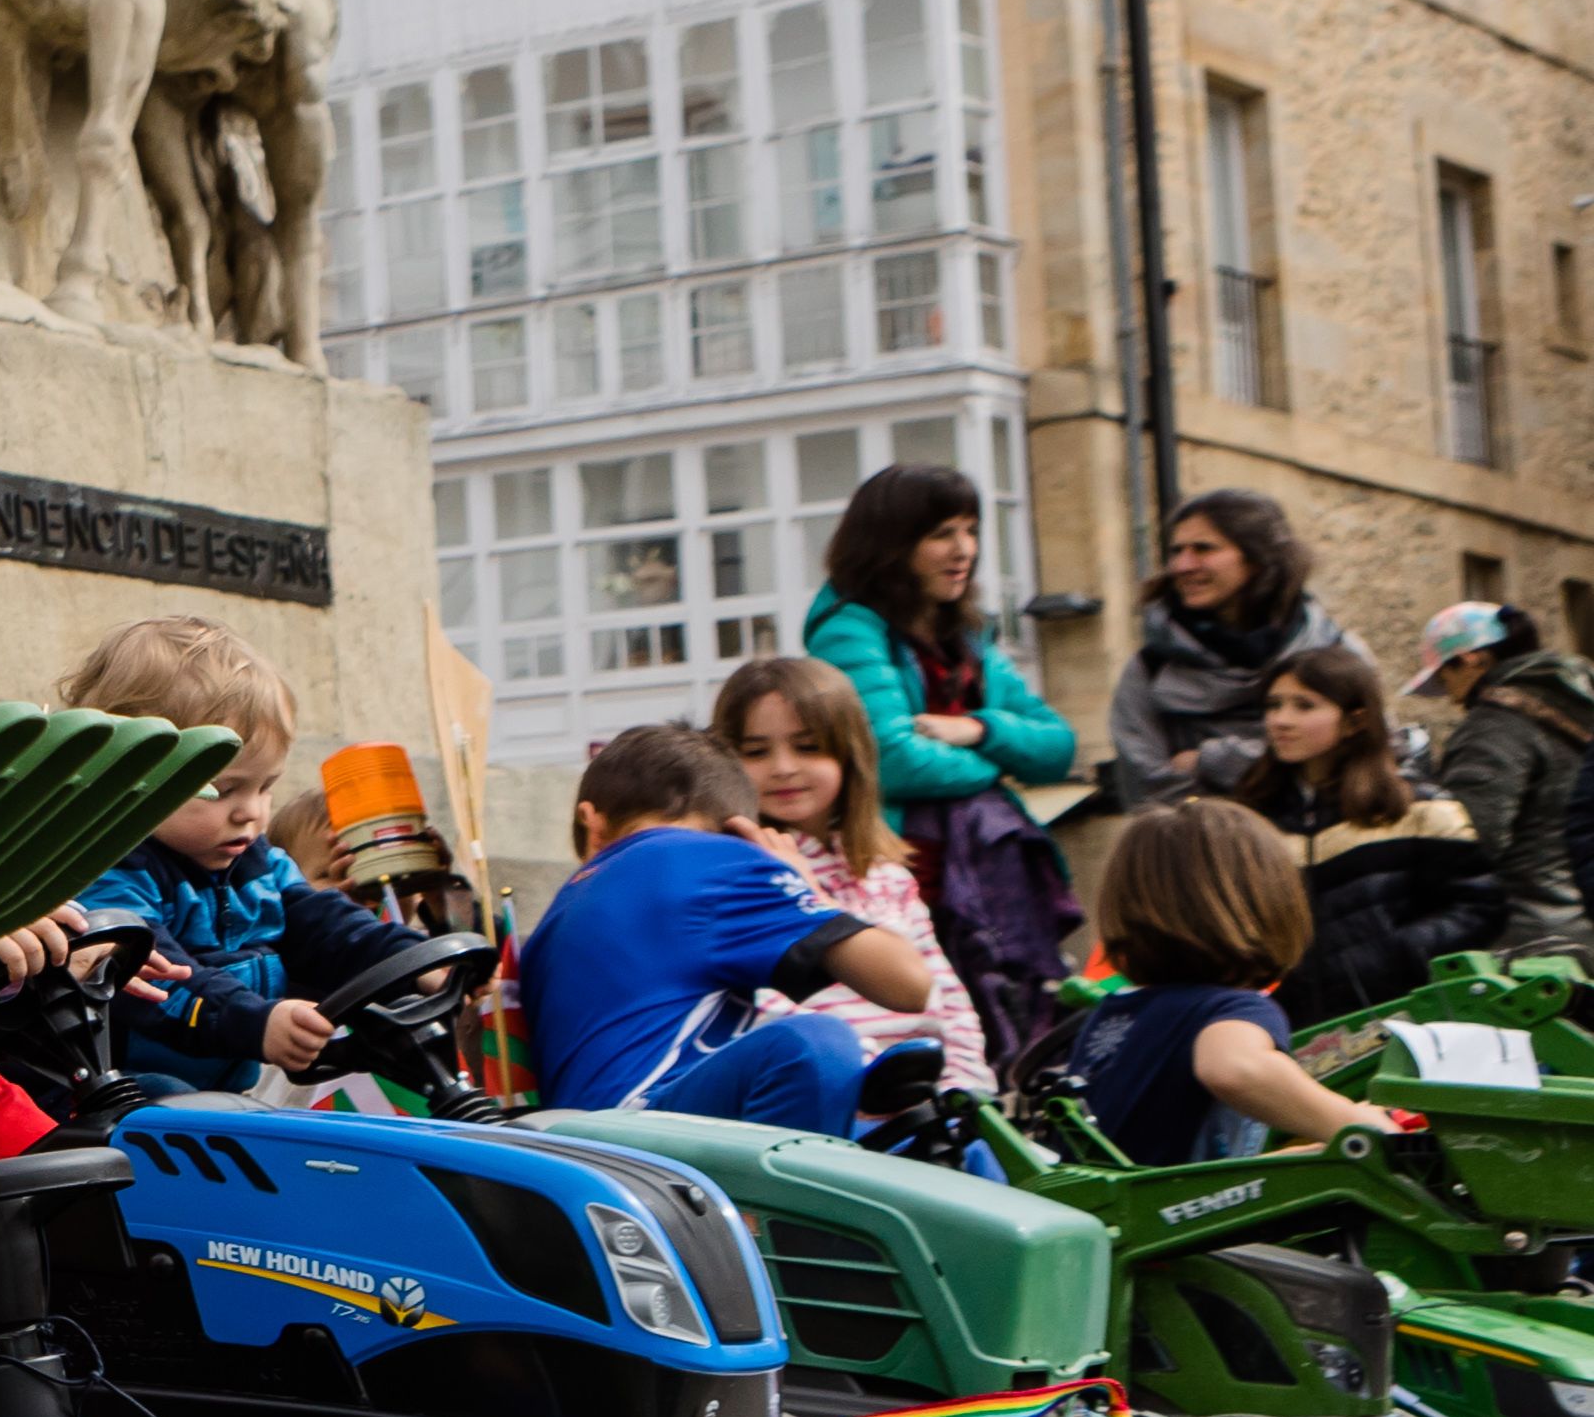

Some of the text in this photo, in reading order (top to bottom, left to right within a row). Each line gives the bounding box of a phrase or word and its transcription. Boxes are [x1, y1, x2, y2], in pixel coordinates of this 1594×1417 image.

[154, 517, 200, 569] DE
[1159, 1178, 1267, 1225] FENDT
[208, 1240, 375, 1294] NEW HOLLAND
